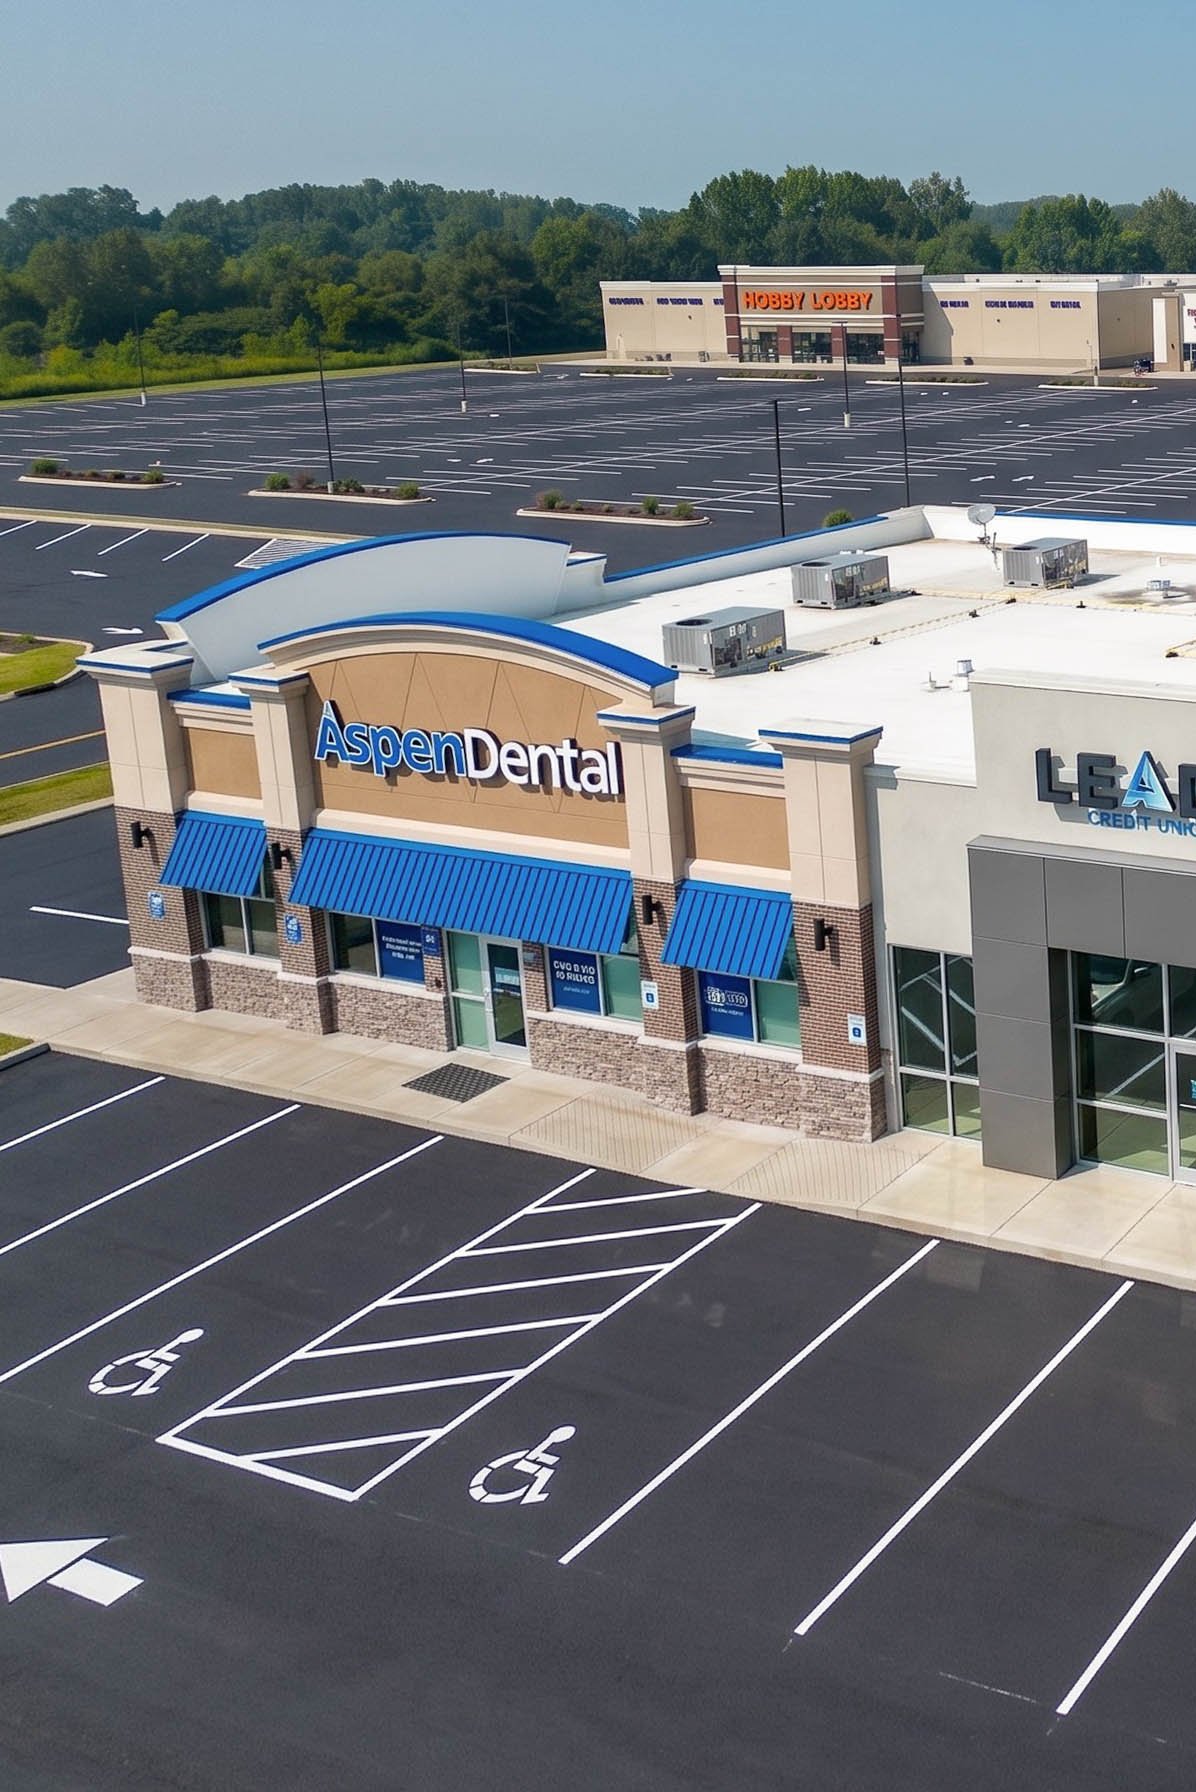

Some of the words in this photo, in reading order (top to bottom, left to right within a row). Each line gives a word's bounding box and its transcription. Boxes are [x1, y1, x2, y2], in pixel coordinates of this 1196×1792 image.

[744, 291, 805, 310] HOBBY
[811, 292, 873, 311] LOBBY
[314, 699, 623, 795] AspenDental
[1088, 811, 1151, 832] CREDIT
